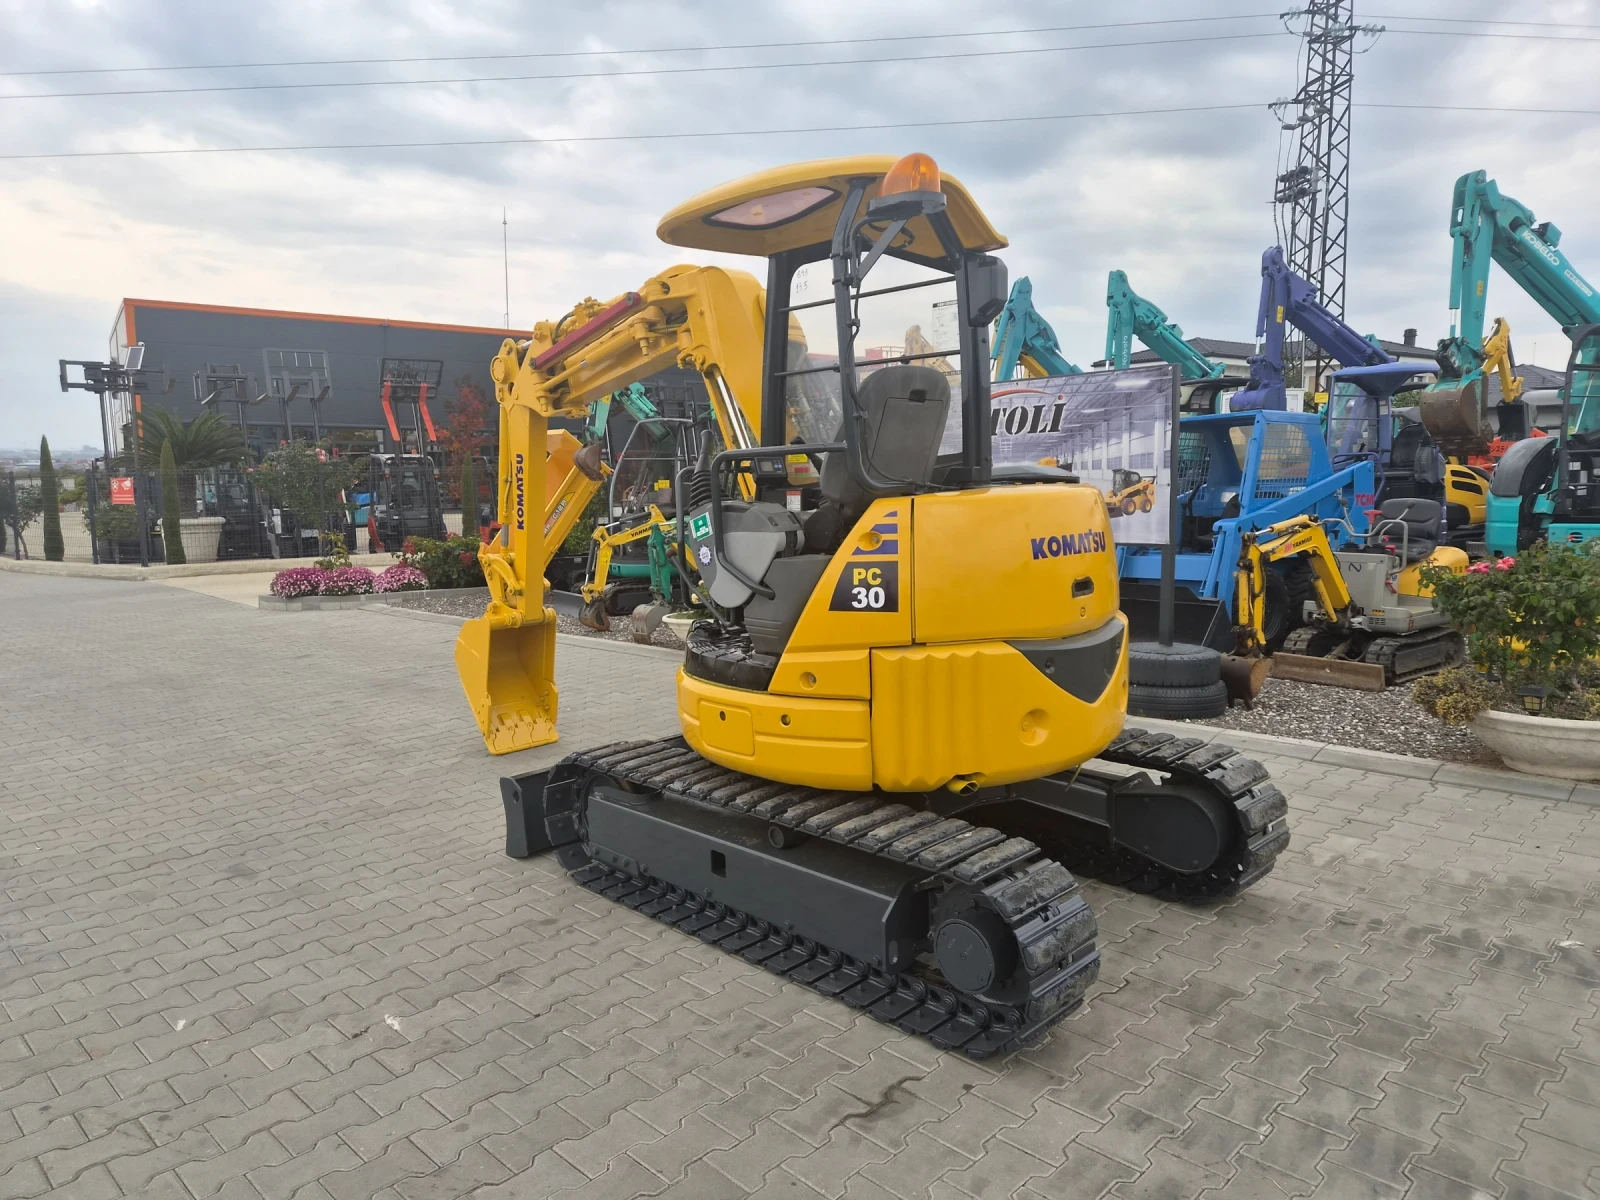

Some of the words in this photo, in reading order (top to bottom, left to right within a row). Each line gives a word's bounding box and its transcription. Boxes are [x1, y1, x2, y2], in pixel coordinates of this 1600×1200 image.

[1522, 230, 1560, 266] KOBELCO
[516, 453, 524, 530] KOMATSU
[1355, 493, 1375, 507] TCM
[1031, 529, 1106, 560] KOMATSU
[1292, 535, 1313, 548] YANMAR
[853, 567, 882, 586] PC
[851, 586, 886, 609] 30
